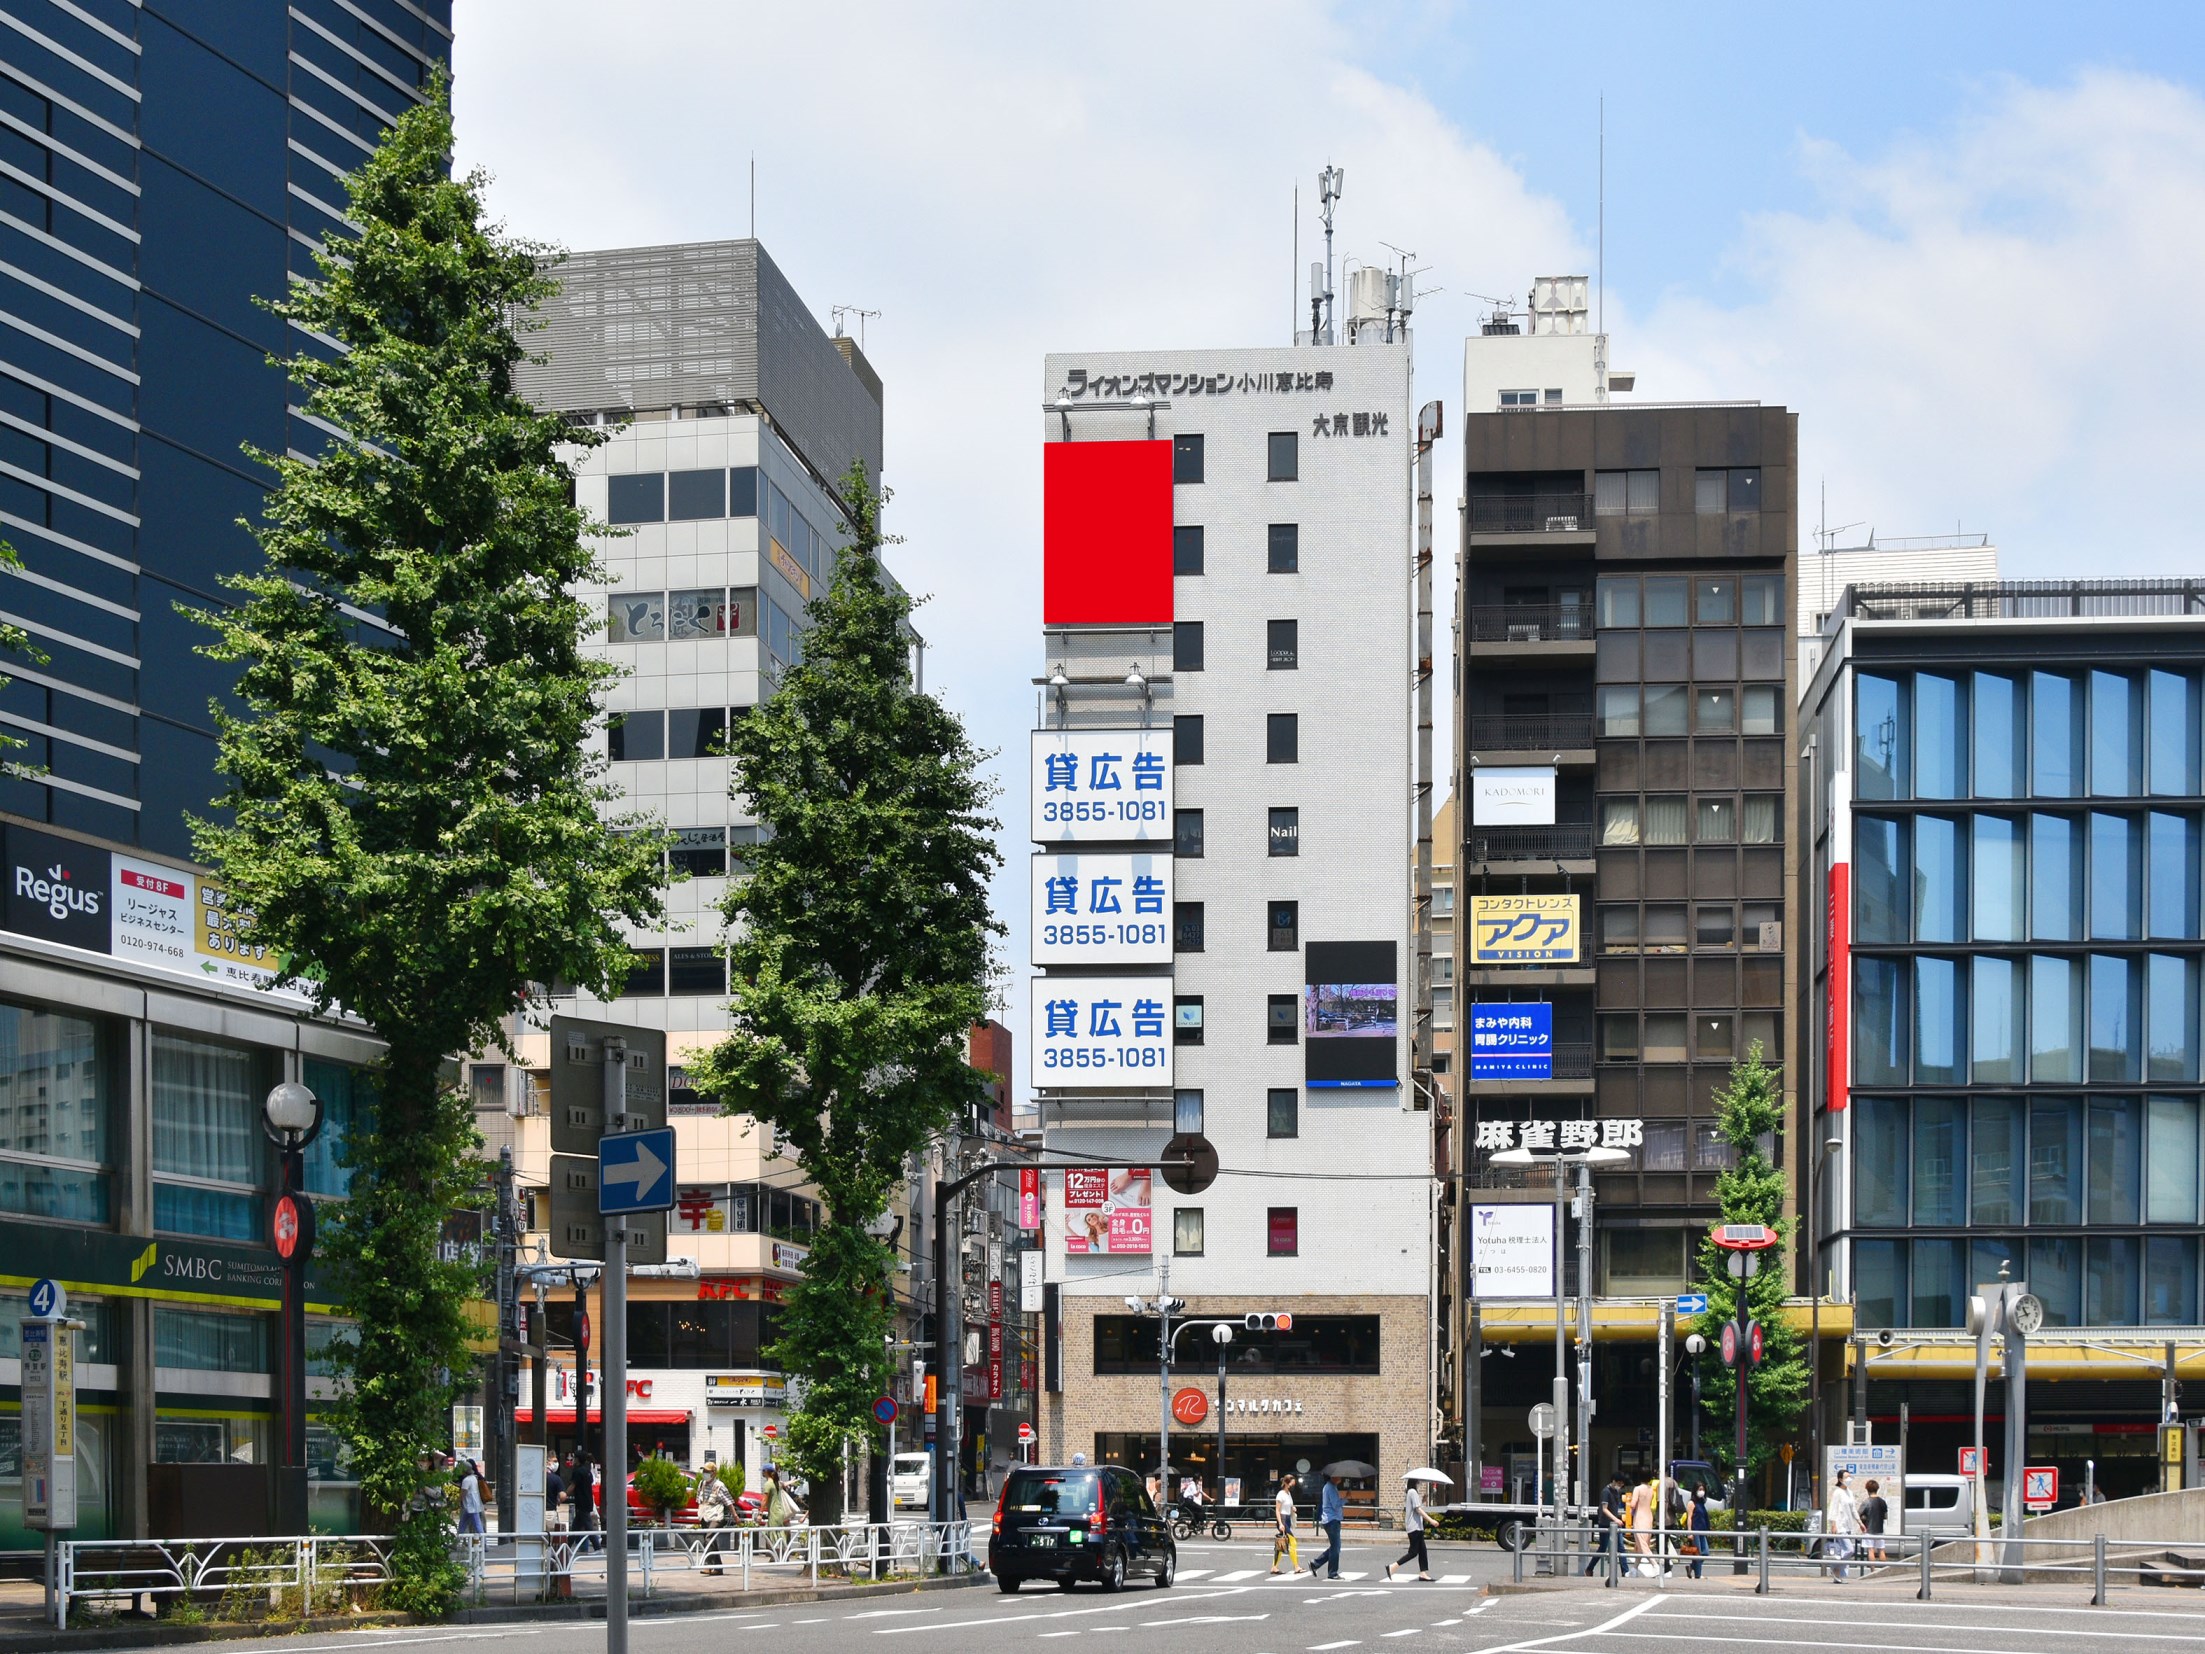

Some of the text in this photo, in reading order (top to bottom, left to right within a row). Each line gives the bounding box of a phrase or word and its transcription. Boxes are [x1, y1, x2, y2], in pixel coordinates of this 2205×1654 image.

[1313, 412, 1389, 437] 大京観光
[1044, 752, 1166, 791] 貸広告
[1484, 788, 1545, 796] KADOMORI
[1043, 800, 1166, 822] 3855-1081
[1270, 826, 1297, 837] Nail
[16, 865, 99, 919] Regus
[1044, 876, 1166, 915] 貸広告
[1478, 896, 1572, 910] コンタクトレンズ
[127, 898, 178, 921] リージャス
[120, 912, 185, 934] ビジネスセンター
[1479, 914, 1569, 946] アクア
[1043, 924, 1166, 945] 3855-1081
[120, 934, 184, 958] 0120-974-668
[1498, 950, 1553, 958] VISION
[1044, 999, 1166, 1038] 貸広告
[1475, 1016, 1532, 1029] まみや内科
[1475, 1033, 1549, 1046] 胃腸クリニック
[1043, 1047, 1166, 1068] 3855-1081
[1475, 1119, 1643, 1149] 麻雀野郎
[1478, 1236, 1548, 1244] Yotuha 税理士法人
[164, 1254, 222, 1281] SMBC
[227, 1272, 262, 1284] BANKING
[33, 1284, 50, 1312] 4
[698, 1279, 750, 1299] KFC
[626, 1380, 653, 1398] FC
